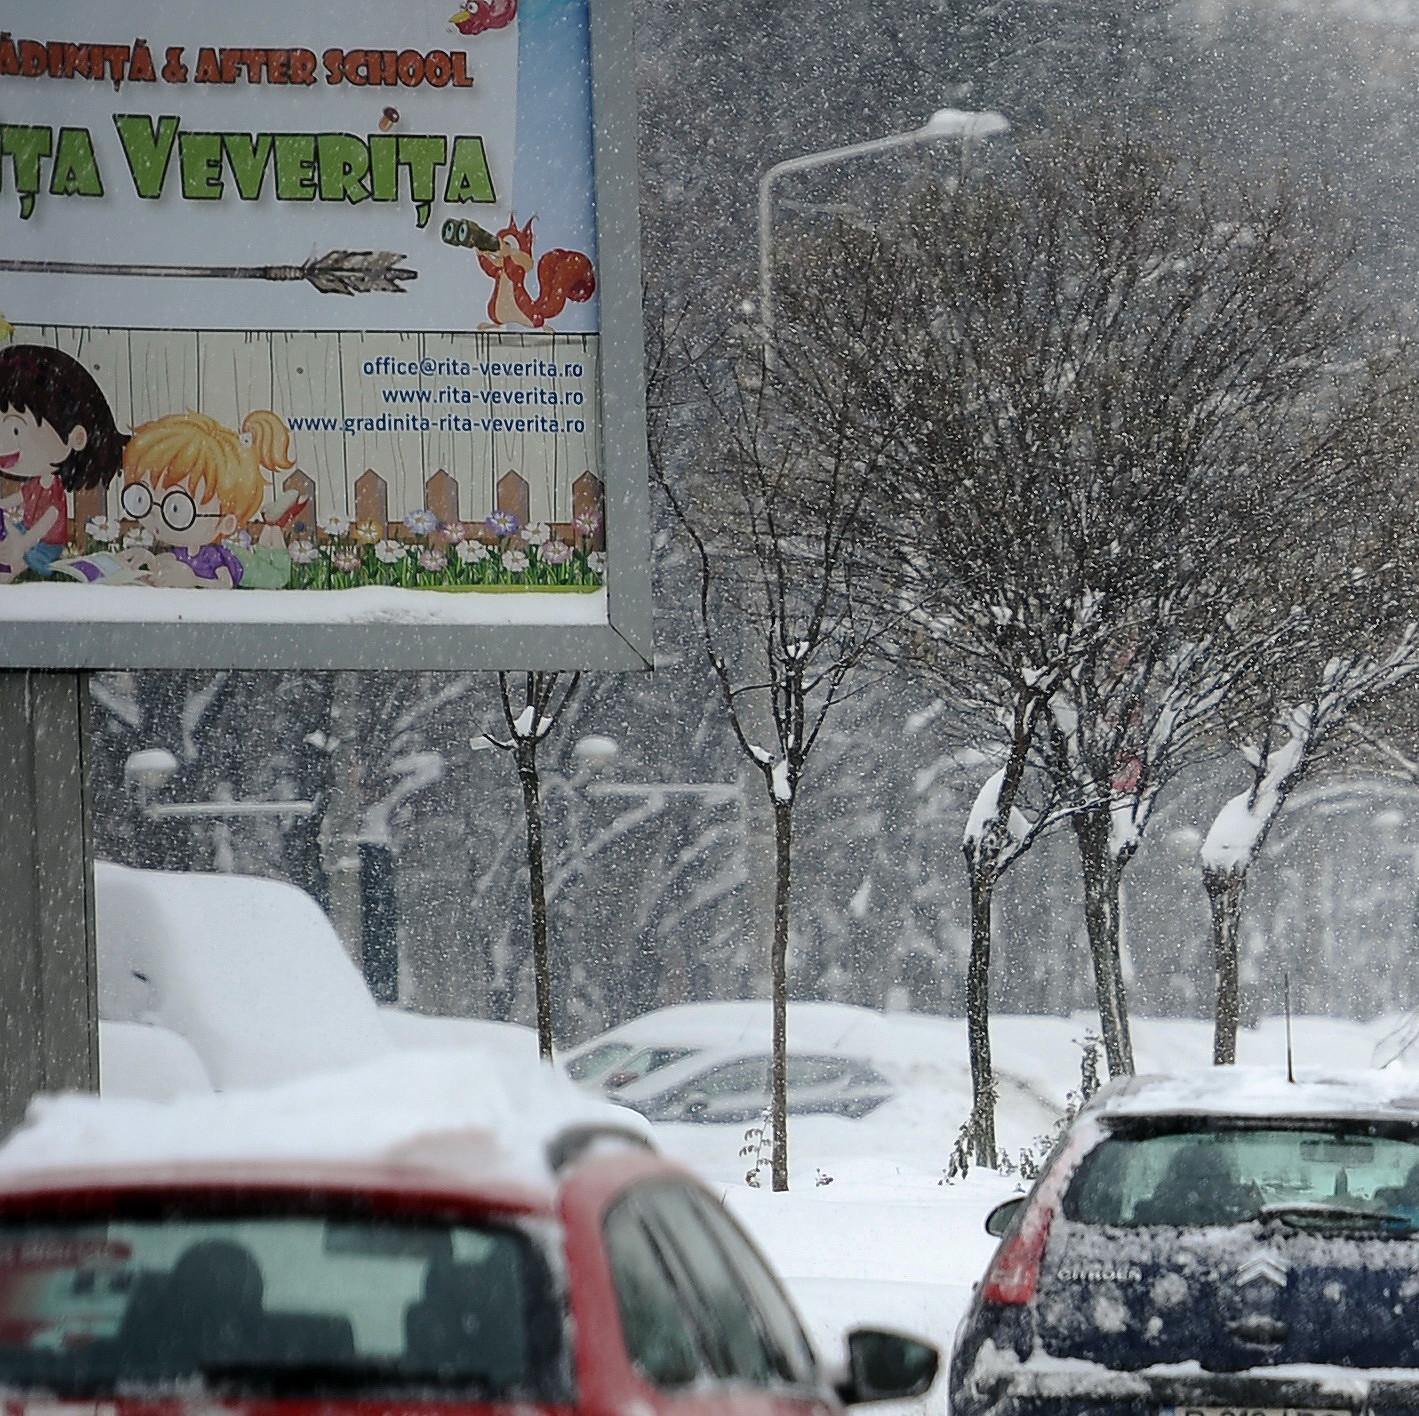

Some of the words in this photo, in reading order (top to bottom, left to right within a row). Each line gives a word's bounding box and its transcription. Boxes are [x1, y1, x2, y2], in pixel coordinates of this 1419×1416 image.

[162, 46, 189, 83] &
[194, 47, 317, 86] AFTER
[322, 49, 474, 87] SCHOOL
[362, 356, 584, 378] office@rita-veverita.ro
[382, 385, 585, 405] www.rita-veverita.ro
[287, 412, 586, 436] www.gradinita-rita-veverita.ro
